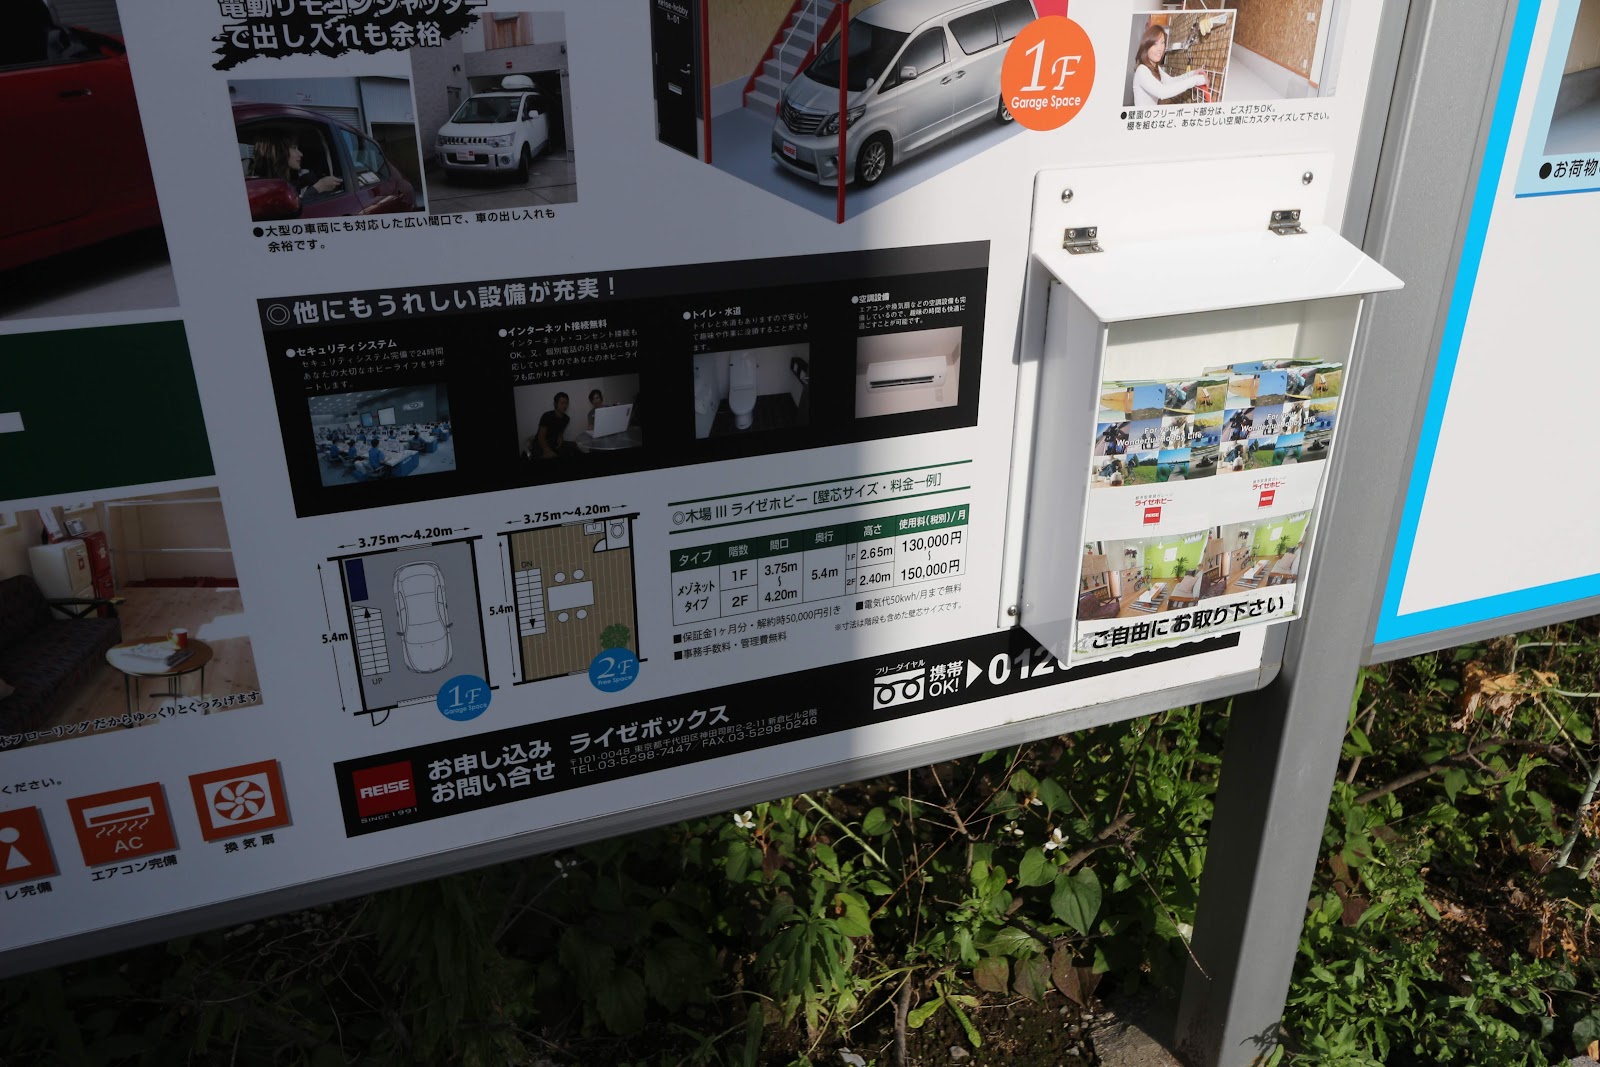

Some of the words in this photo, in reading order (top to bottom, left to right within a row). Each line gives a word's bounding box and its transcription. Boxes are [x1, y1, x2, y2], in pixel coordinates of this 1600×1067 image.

[224, 21, 442, 50] で出し入れも余裕
[1011, 95, 1048, 110] Garage
[1051, 94, 1081, 108] Space
[1127, 112, 1330, 130] 棚を組むなど、あなたらしい空間にカスタマイズして下さい。
[1553, 158, 1600, 179] お荷物
[265, 209, 556, 238] 大型の車両にも対応した広い間口で、車の出し入れも
[268, 240, 326, 253] 余裕です。
[293, 276, 617, 325] 他にもうれしい設備が充実！
[858, 292, 890, 304] 空調設備
[692, 306, 741, 320] トイレ・水道
[508, 319, 608, 336] インターネット接続無料
[296, 338, 398, 357] セキュリティシステム
[302, 346, 445, 368] セキュリティシステム完備で24時間
[303, 358, 445, 381] あなたの大切なホビーライフをサポ
[513, 369, 570, 381] フも広がります。
[1267, 412, 1279, 420] For
[1144, 426, 1157, 435] For
[1158, 424, 1178, 435] your
[732, 495, 808, 517] ライゼホビー
[814, 530, 835, 544] 奥行
[863, 523, 883, 537] 高さ
[769, 538, 790, 551] 間口
[901, 530, 963, 554] 130,000円
[678, 549, 713, 567] タイプ
[728, 544, 749, 559] 階数
[846, 552, 856, 562] 1F
[860, 546, 893, 561] 2.65m
[731, 569, 749, 582] 1F
[764, 562, 798, 577] 3.75m
[811, 567, 839, 581] 5.4m
[900, 559, 961, 582] 150,000円
[677, 579, 715, 597] メゾネット
[846, 577, 856, 587] 2F
[859, 572, 891, 587] 2.40m
[684, 595, 709, 614] タイプ
[731, 596, 749, 609] 2F
[764, 589, 798, 603] 4.20m
[488, 602, 514, 616] 5.4m
[1092, 596, 1284, 649] ご自由にお取り下さい
[321, 630, 349, 644] 5.4m
[683, 630, 787, 660] 事務手数料・管理費無料
[596, 656, 634, 680] 2F
[875, 659, 926, 676] フリーダイヤル
[929, 659, 964, 682] 携帯
[372, 677, 384, 686] UP
[612, 674, 633, 684] Space
[448, 685, 482, 708] 1F
[928, 680, 960, 697] OK!
[443, 705, 468, 716] Garage
[468, 701, 488, 712] Space
[569, 705, 730, 754] ライゼボックス
[427, 740, 552, 781] お申し込み
[1, 777, 63, 796] ください。
[360, 779, 410, 800] REISE
[430, 759, 556, 804] お問い合せ
[114, 836, 144, 853] AC
[224, 833, 276, 854] 換気扇
[91, 854, 178, 882] エアコン完備
[5, 881, 53, 901] レ完備
